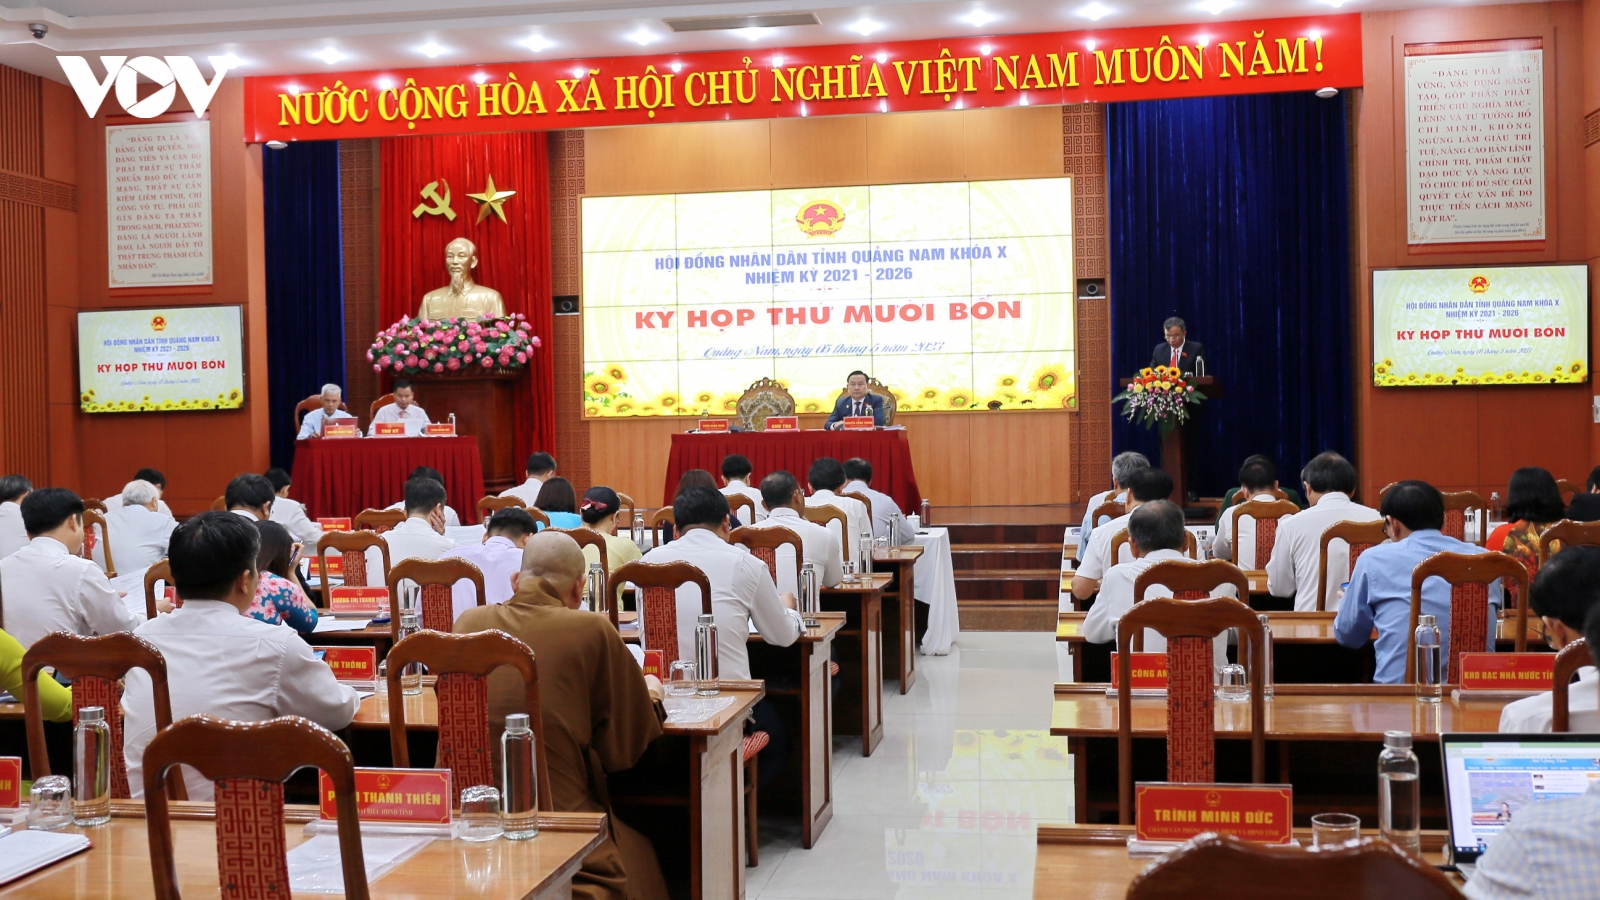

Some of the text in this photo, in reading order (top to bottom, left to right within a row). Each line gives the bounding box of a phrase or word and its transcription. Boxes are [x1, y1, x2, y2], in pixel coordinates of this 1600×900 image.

[278, 31, 1324, 129] NƯỚC CỘNG HÒA XÃ HỘI CHỦ NGHĨA VIỆT NAM MUÔN NĂM!
[1417, 77, 1530, 90] VỮNG, VẬN DỤNG SÁNG
[1418, 114, 1446, 123] LÊNIN
[1465, 113, 1478, 121] TƯ
[1481, 110, 1514, 119] TƯỞNG
[1518, 108, 1532, 118] HỒ
[1418, 144, 1532, 157] TUỆ, NÂNG CAO BẢN LĨNH
[1419, 166, 1532, 179] ĐẠO ĐỨC VÀ NĂNG LỰC
[1419, 200, 1533, 213] THỰC TIỄN CÁCH MẠNG
[655, 244, 1007, 272] HỘI ĐỒNG NHÂN DÂN TỈNH QUẢNG NAM KHÓA X
[746, 270, 794, 286] NHIỆM
[800, 268, 818, 283] KỲ
[824, 269, 858, 282] 2021
[876, 268, 913, 281] 2026
[1406, 301, 1418, 311] HỘI
[1419, 300, 1438, 310] ĐỒNG
[1439, 300, 1458, 309] NHÂN
[1459, 299, 1474, 309] DÂN
[1475, 298, 1491, 308] TỈNH
[1492, 298, 1516, 308] QUẢNG
[1535, 298, 1553, 307] KHÓA
[636, 295, 1021, 332] KỲ HỌP THỨ MƯỜI BỐN
[1446, 309, 1468, 320] NHIỆM
[1470, 308, 1479, 318] KỲ
[1503, 309, 1519, 317] 2026
[1397, 325, 1566, 343] KỲ HỌP THỨ MƯỜI BỐN
[104, 339, 113, 347] HỘI
[113, 337, 128, 346] ĐỒNG
[129, 337, 143, 345] NHÂN
[144, 336, 155, 344] DÂN
[156, 336, 168, 344] TỈNH
[169, 336, 187, 344] QUẢNG
[201, 335, 215, 343] KHÓA
[134, 345, 151, 354] NHIỆM
[152, 344, 159, 352] KỲ
[97, 358, 226, 375] KỲ HỌP THỨ MƯỜI BỐN
[341, 660, 367, 669] THÔNG
[1132, 669, 1168, 678] CÔNG AN
[1464, 672, 1479, 680] KHO
[1482, 672, 1498, 681] BẠC
[1500, 670, 1516, 680] NHÀ
[1518, 670, 1540, 680] NƯỚC
[363, 792, 403, 804] THANH
[406, 792, 441, 805] THIÊN
[1154, 808, 1274, 824] TRÌNH MINH ĐỨC
